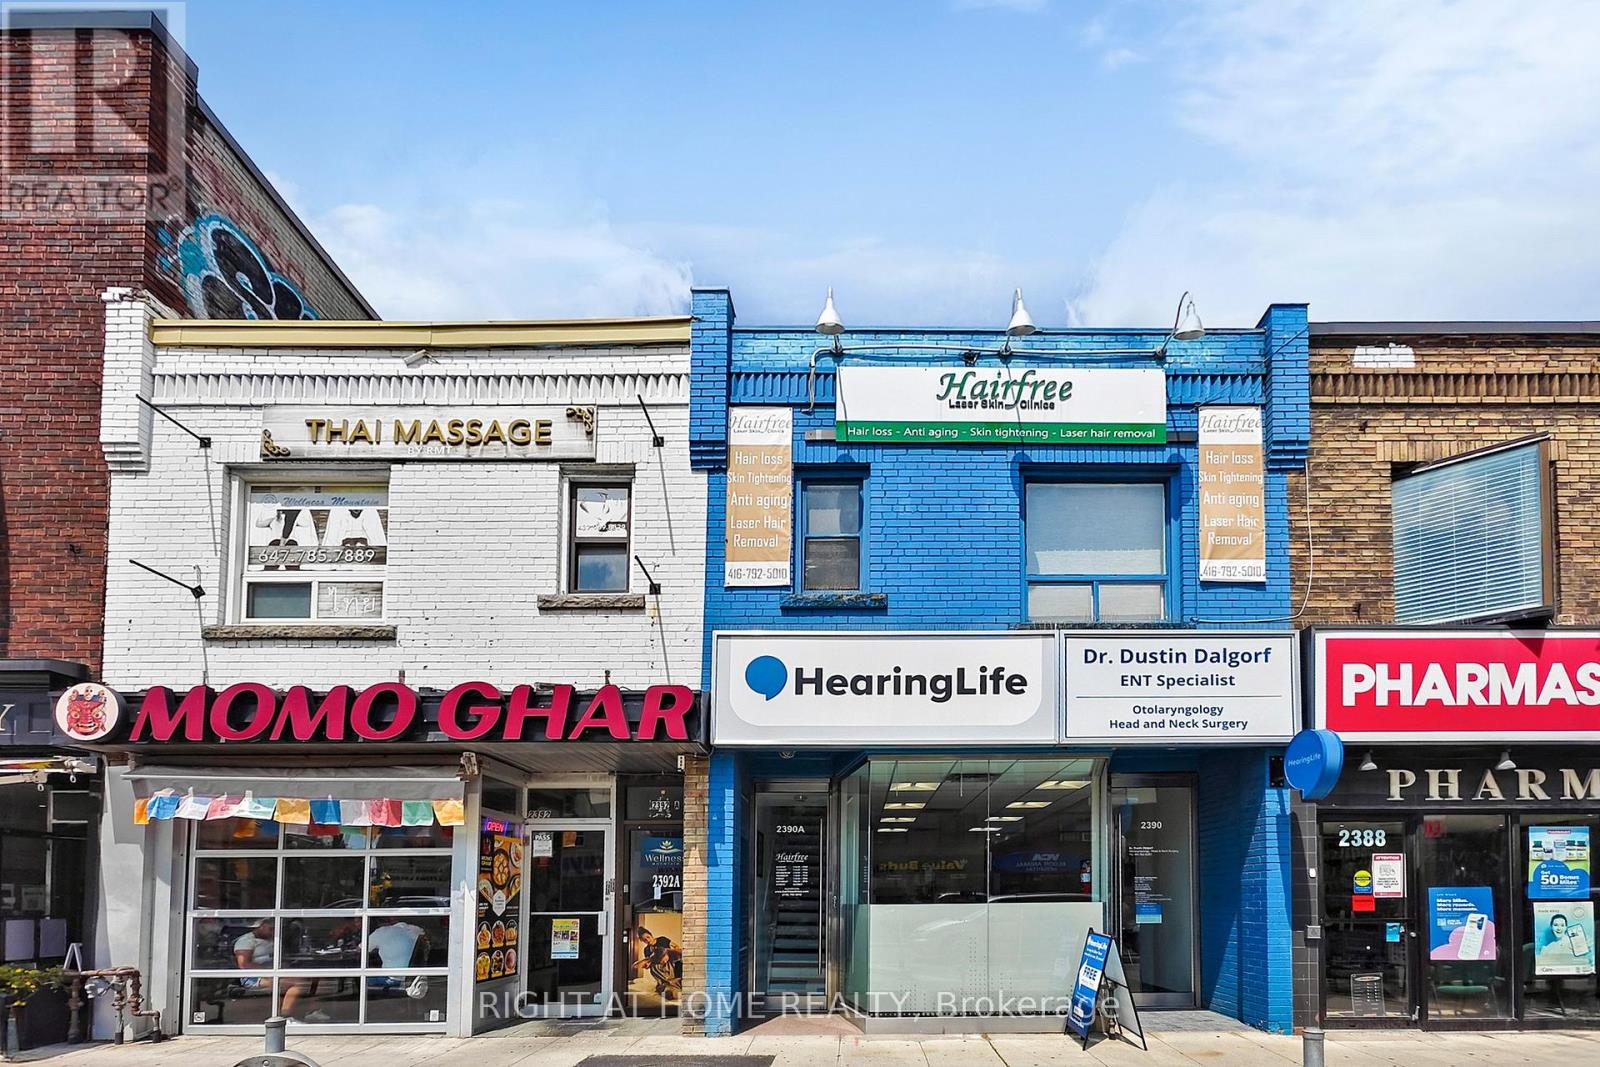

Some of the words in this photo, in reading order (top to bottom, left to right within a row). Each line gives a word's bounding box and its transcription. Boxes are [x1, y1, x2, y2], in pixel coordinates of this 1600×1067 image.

[936, 370, 1073, 411] Hairfree
[949, 400, 979, 409] Laser
[981, 400, 1003, 409] Skin
[1020, 400, 1055, 410] Clinics
[304, 418, 382, 446] THAI
[393, 418, 553, 446] MASSAGE
[847, 427, 870, 436] Hair
[872, 427, 893, 436] loss
[903, 427, 925, 436] Anti
[928, 427, 959, 438] aging
[970, 427, 992, 436] Skin
[995, 428, 1049, 439] tightening
[1060, 429, 1087, 438] Laser
[1090, 429, 1109, 438] hair
[1113, 429, 1156, 438] removal
[407, 446, 424, 455] BY
[426, 446, 452, 455] RMT
[1205, 450, 1229, 464] Hair
[1231, 450, 1254, 464] loss
[735, 451, 758, 465] Hair
[761, 451, 784, 465] loss
[727, 471, 745, 483] Skin
[747, 471, 792, 485] Tightening
[1199, 471, 1216, 483] Skin
[1218, 471, 1263, 485] Tightening
[730, 491, 753, 506] Anti
[756, 493, 788, 509] aging
[1203, 490, 1225, 505] Anti
[1229, 492, 1260, 507] aging
[730, 515, 761, 529] Laser
[763, 515, 787, 529] Hair
[1204, 513, 1234, 527] Laser
[1237, 513, 1259, 527] Hair
[733, 533, 779, 548] Removal
[1207, 531, 1252, 545] Removal
[258, 548, 376, 564] 647.785.7889
[727, 567, 788, 580] 416-792-5010
[1202, 565, 1262, 577] 416-792-5010
[1083, 648, 1113, 664] Dr.
[1120, 648, 1187, 664] Dustin
[1194, 647, 1272, 667] Dalgorf
[794, 665, 1028, 703] HearingLife
[1120, 675, 1152, 686] ENT
[1156, 674, 1236, 689] Specialist
[128, 681, 420, 741] MOMO
[437, 681, 695, 740] GHAR
[1132, 705, 1224, 716] Otolaryngology
[1109, 719, 1140, 729] Head
[1143, 719, 1165, 729] and
[1169, 719, 1199, 729] Neck
[1202, 719, 1249, 730] Surgery
[1287, 753, 1321, 767] HearingLife
[1385, 768, 1600, 801] PHARM
[528, 810, 552, 819] 2392
[486, 821, 504, 832] OPEN
[776, 825, 806, 833] 2390A
[1140, 821, 1162, 829] 2390
[1338, 829, 1386, 847] 2388
[775, 852, 809, 862] Hairfree
[652, 874, 680, 888] 2392A
[1540, 874, 1559, 885] 50
